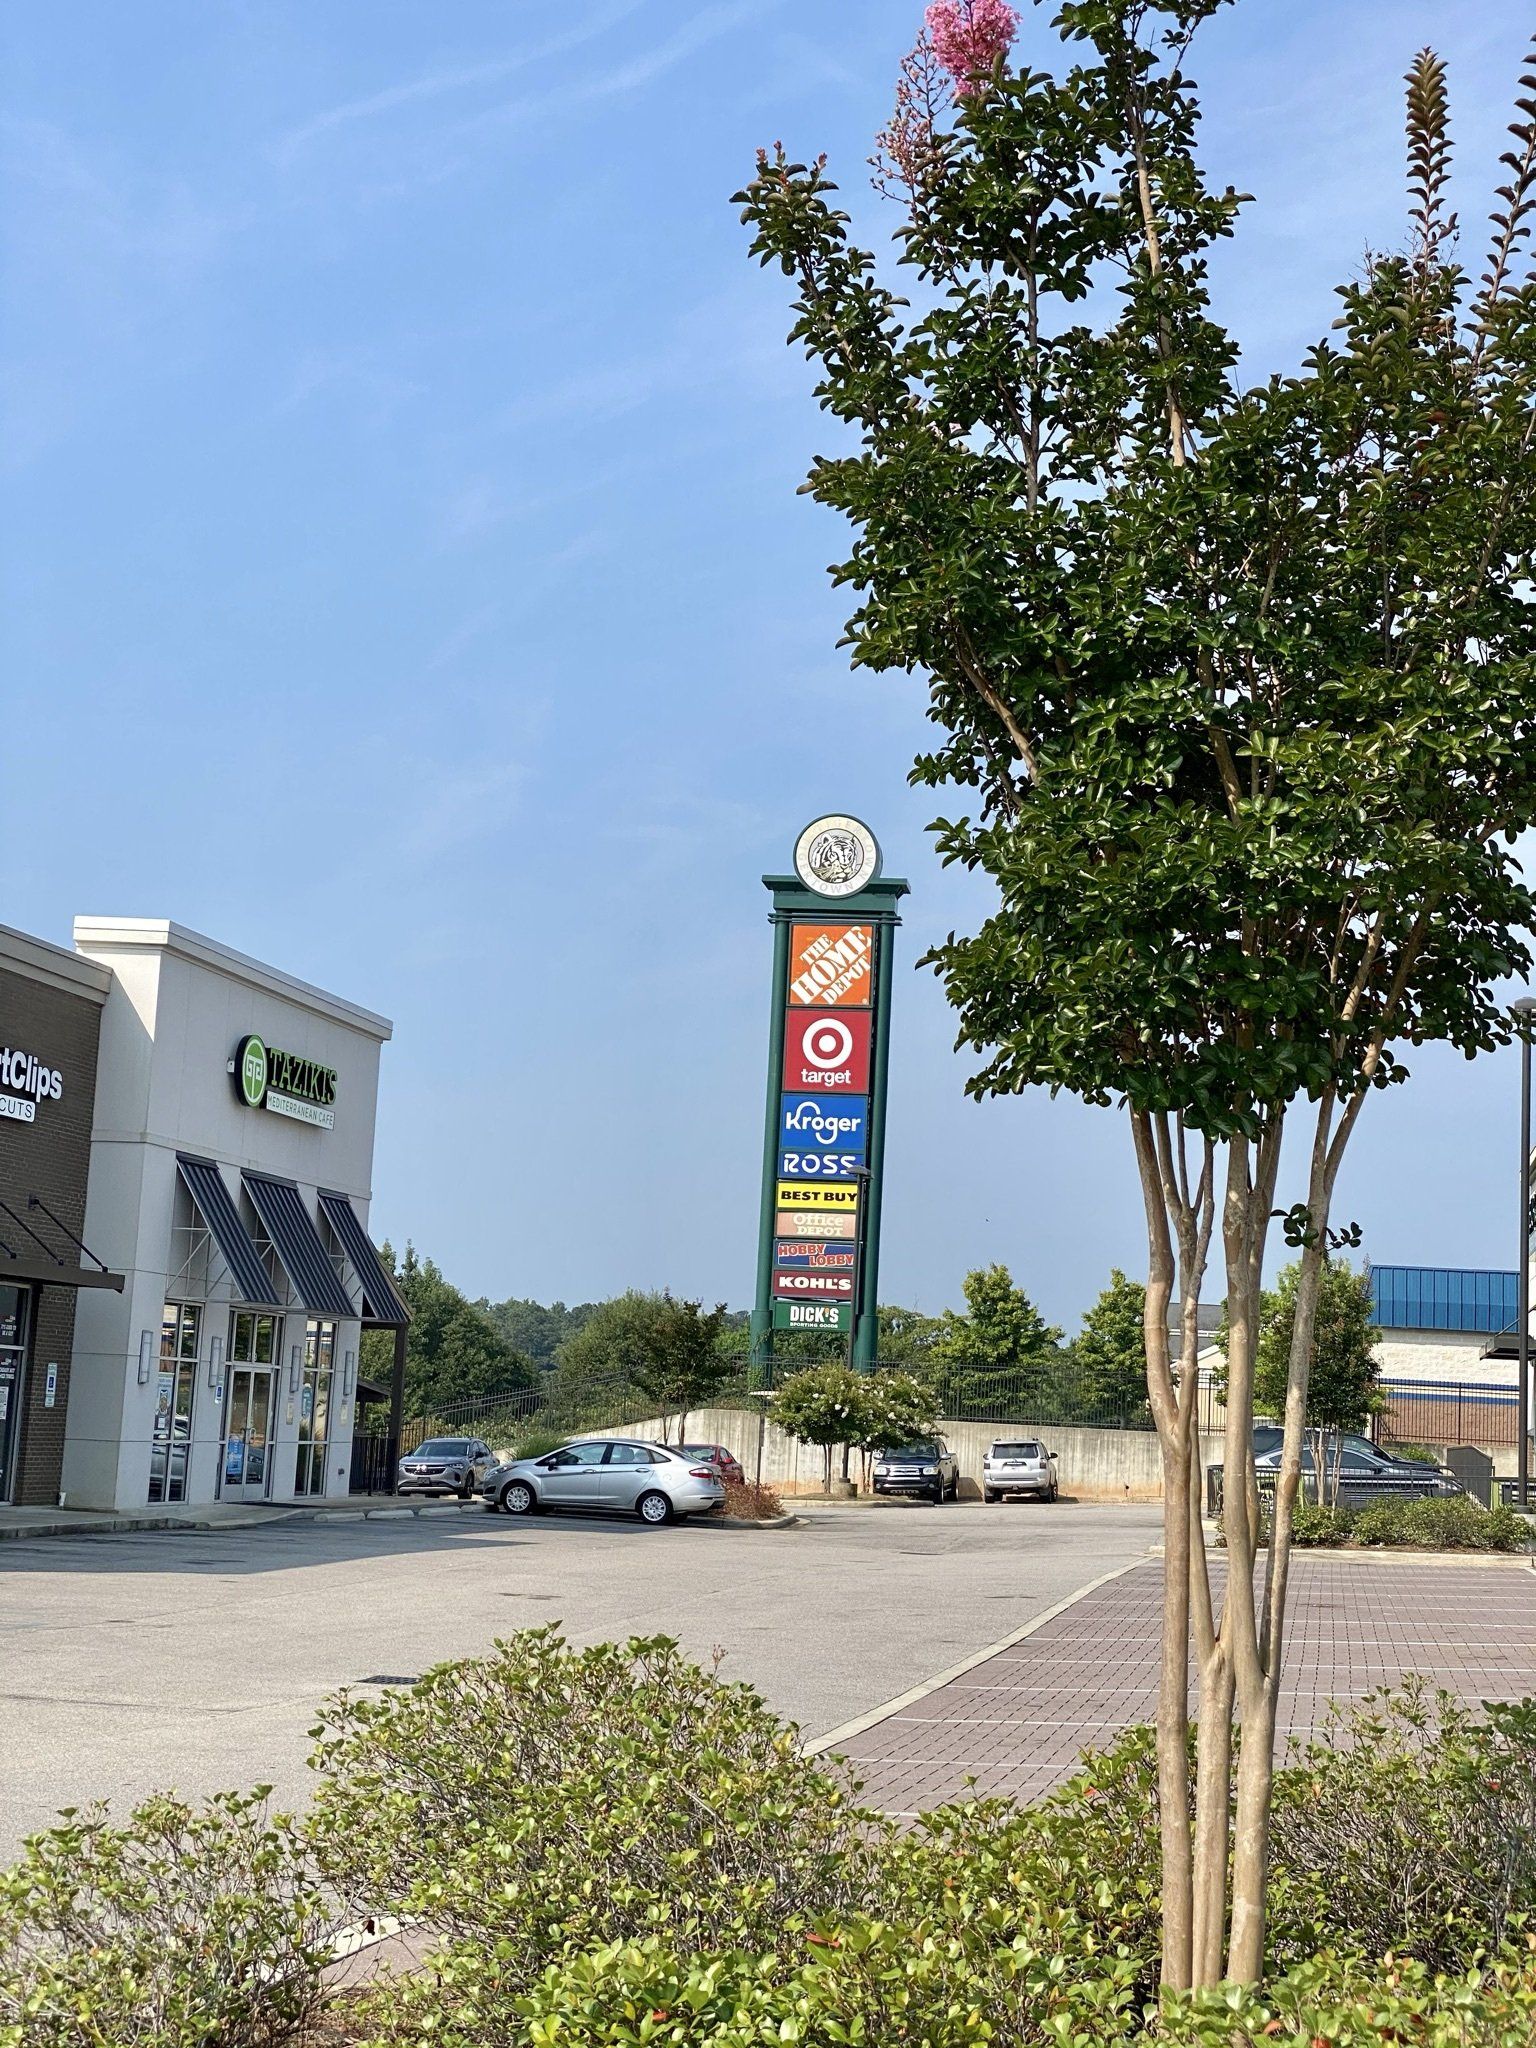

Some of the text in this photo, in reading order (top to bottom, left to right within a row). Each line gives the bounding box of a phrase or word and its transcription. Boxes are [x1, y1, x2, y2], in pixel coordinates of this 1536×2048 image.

[800, 933, 834, 966] THE
[790, 926, 872, 1005] HOME
[821, 954, 871, 1005] DEPOT
[0, 1047, 62, 1103] tClips
[801, 1068, 852, 1086] target
[267, 1094, 318, 1121] MEDITERRANEAN
[785, 1101, 861, 1145] Kroger
[784, 1153, 856, 1175] ROSS
[781, 1190, 858, 1202] BEST BUY
[793, 1213, 844, 1226] Office
[796, 1226, 844, 1237] DEPOT
[778, 1243, 826, 1257] HOBBY
[808, 1254, 854, 1267] LOBBY
[779, 1276, 852, 1291] KOHL'S
[790, 1305, 839, 1324] DICK'S
